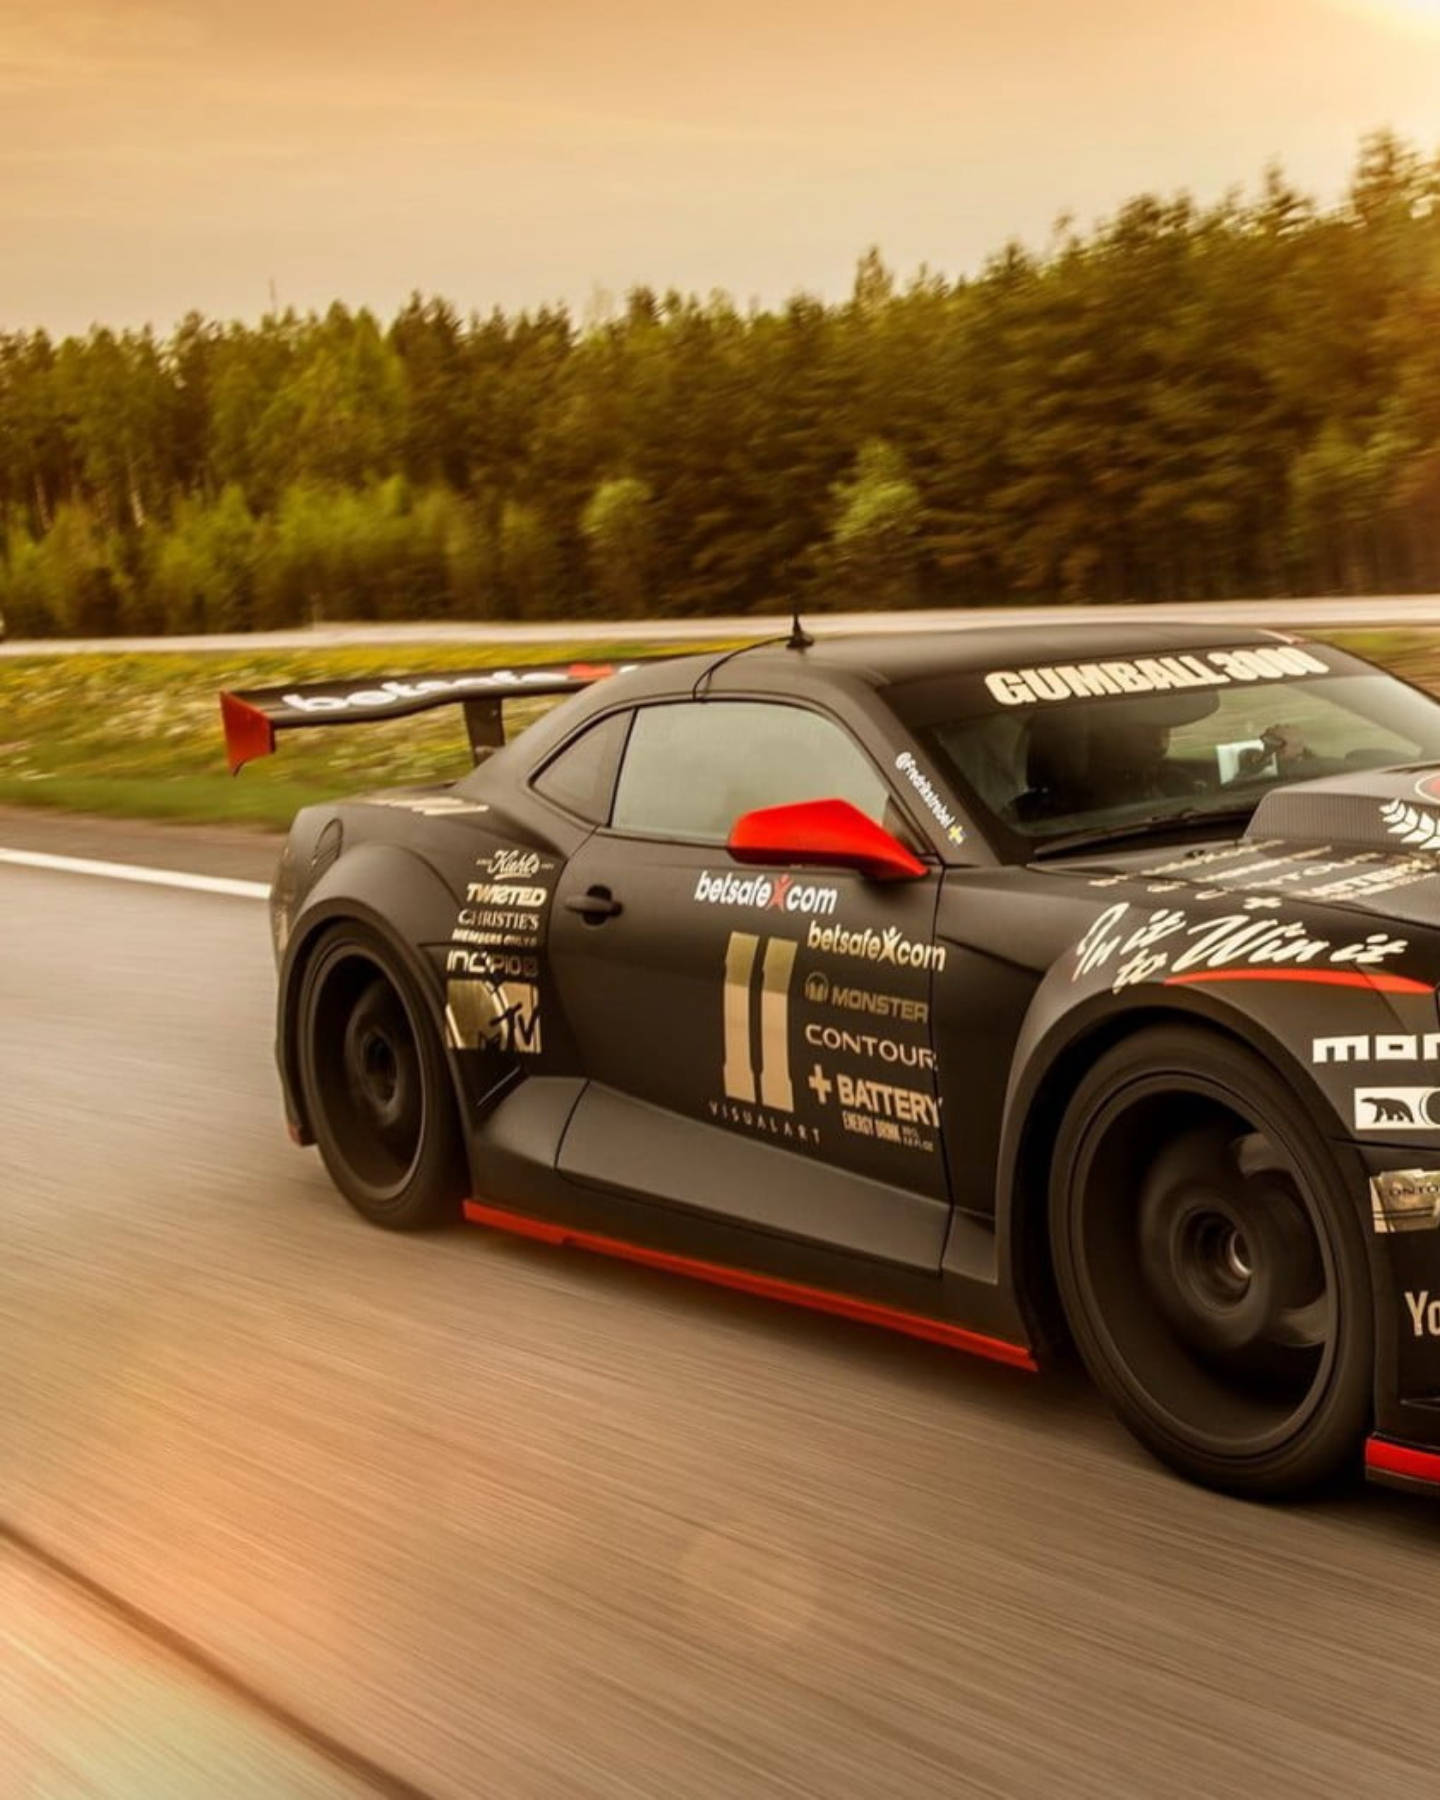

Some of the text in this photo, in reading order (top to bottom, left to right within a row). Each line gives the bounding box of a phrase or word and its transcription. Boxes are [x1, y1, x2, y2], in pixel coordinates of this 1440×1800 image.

[984, 646, 1330, 705] GUMBALL 3000
[1171, 915, 1329, 972] Win
[831, 987, 929, 1024] MONSTER
[805, 1024, 939, 1071] CONTOUR
[836, 1073, 942, 1128] BATTERY
